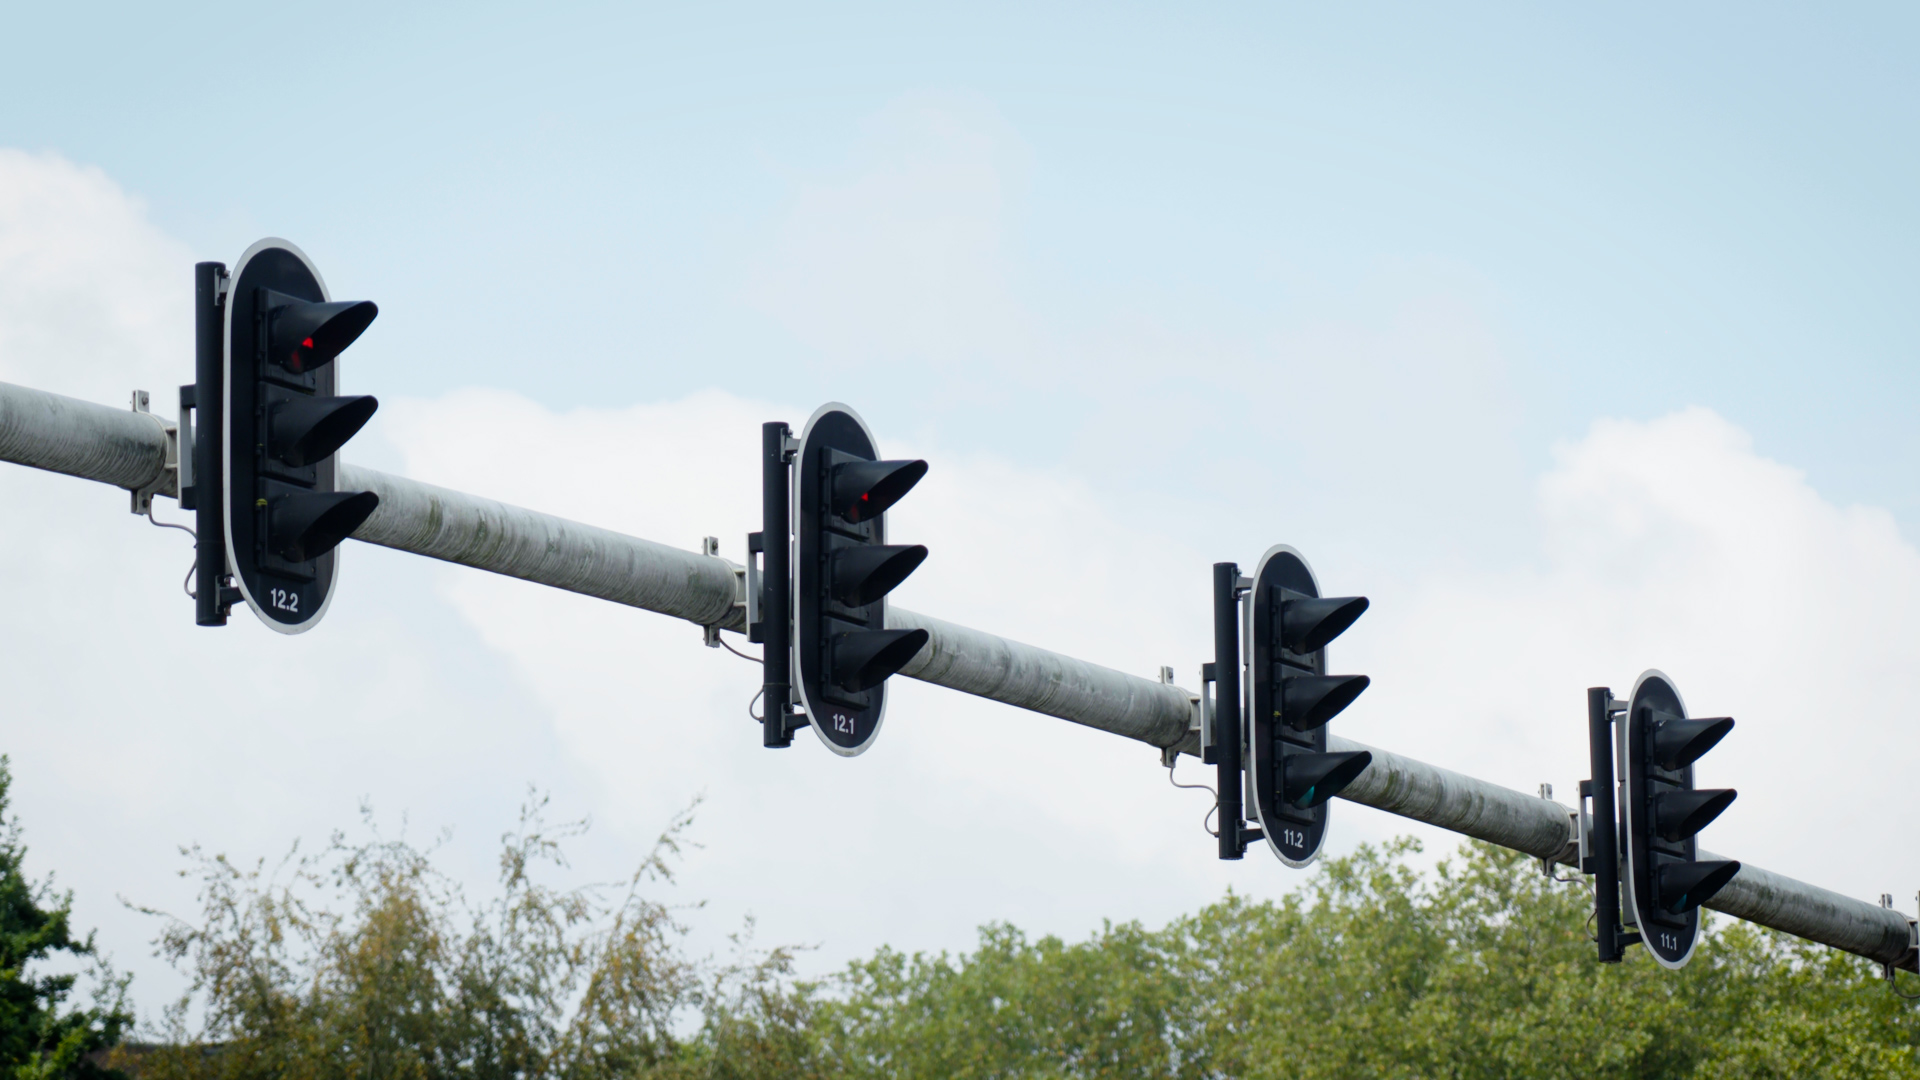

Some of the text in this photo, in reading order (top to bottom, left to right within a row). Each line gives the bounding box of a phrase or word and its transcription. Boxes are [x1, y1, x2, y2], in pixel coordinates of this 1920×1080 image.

[270, 588, 299, 613] 12.2
[832, 713, 854, 735] 12.1
[1284, 828, 1304, 849] 11.2
[1660, 932, 1677, 951] 11.1
